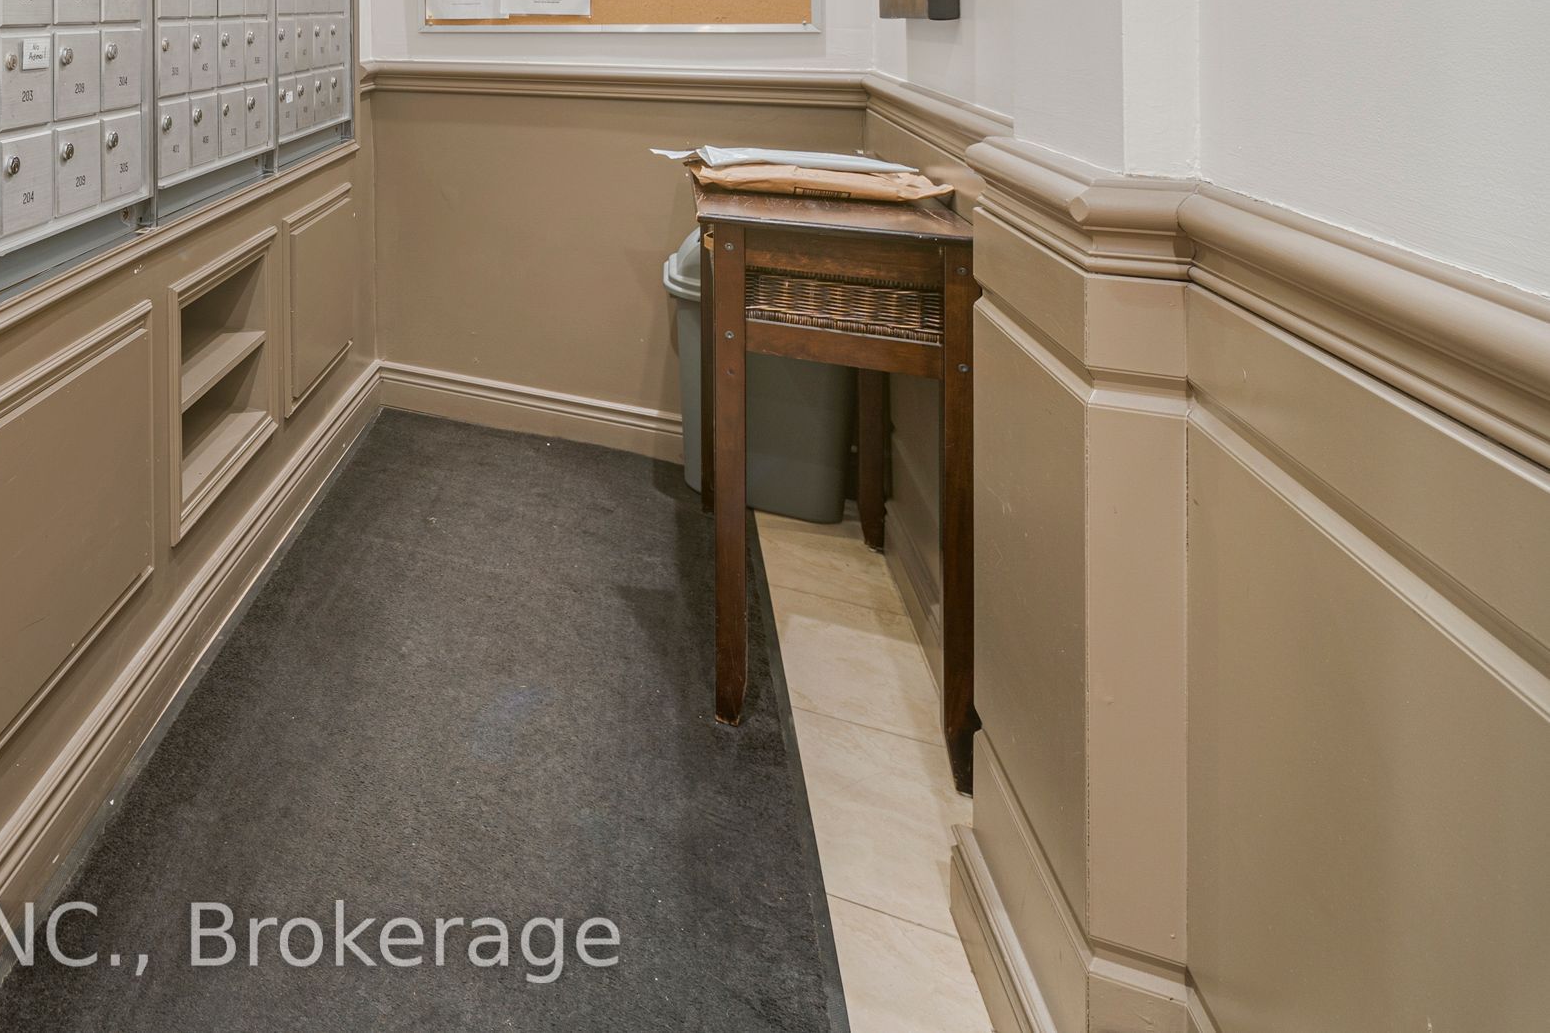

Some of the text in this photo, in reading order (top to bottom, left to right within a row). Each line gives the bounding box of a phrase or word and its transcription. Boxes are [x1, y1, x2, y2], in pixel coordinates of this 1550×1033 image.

[118, 76, 128, 87] 304
[22, 91, 34, 103] 203
[119, 163, 129, 174] 305
[22, 191, 35, 205] 204
